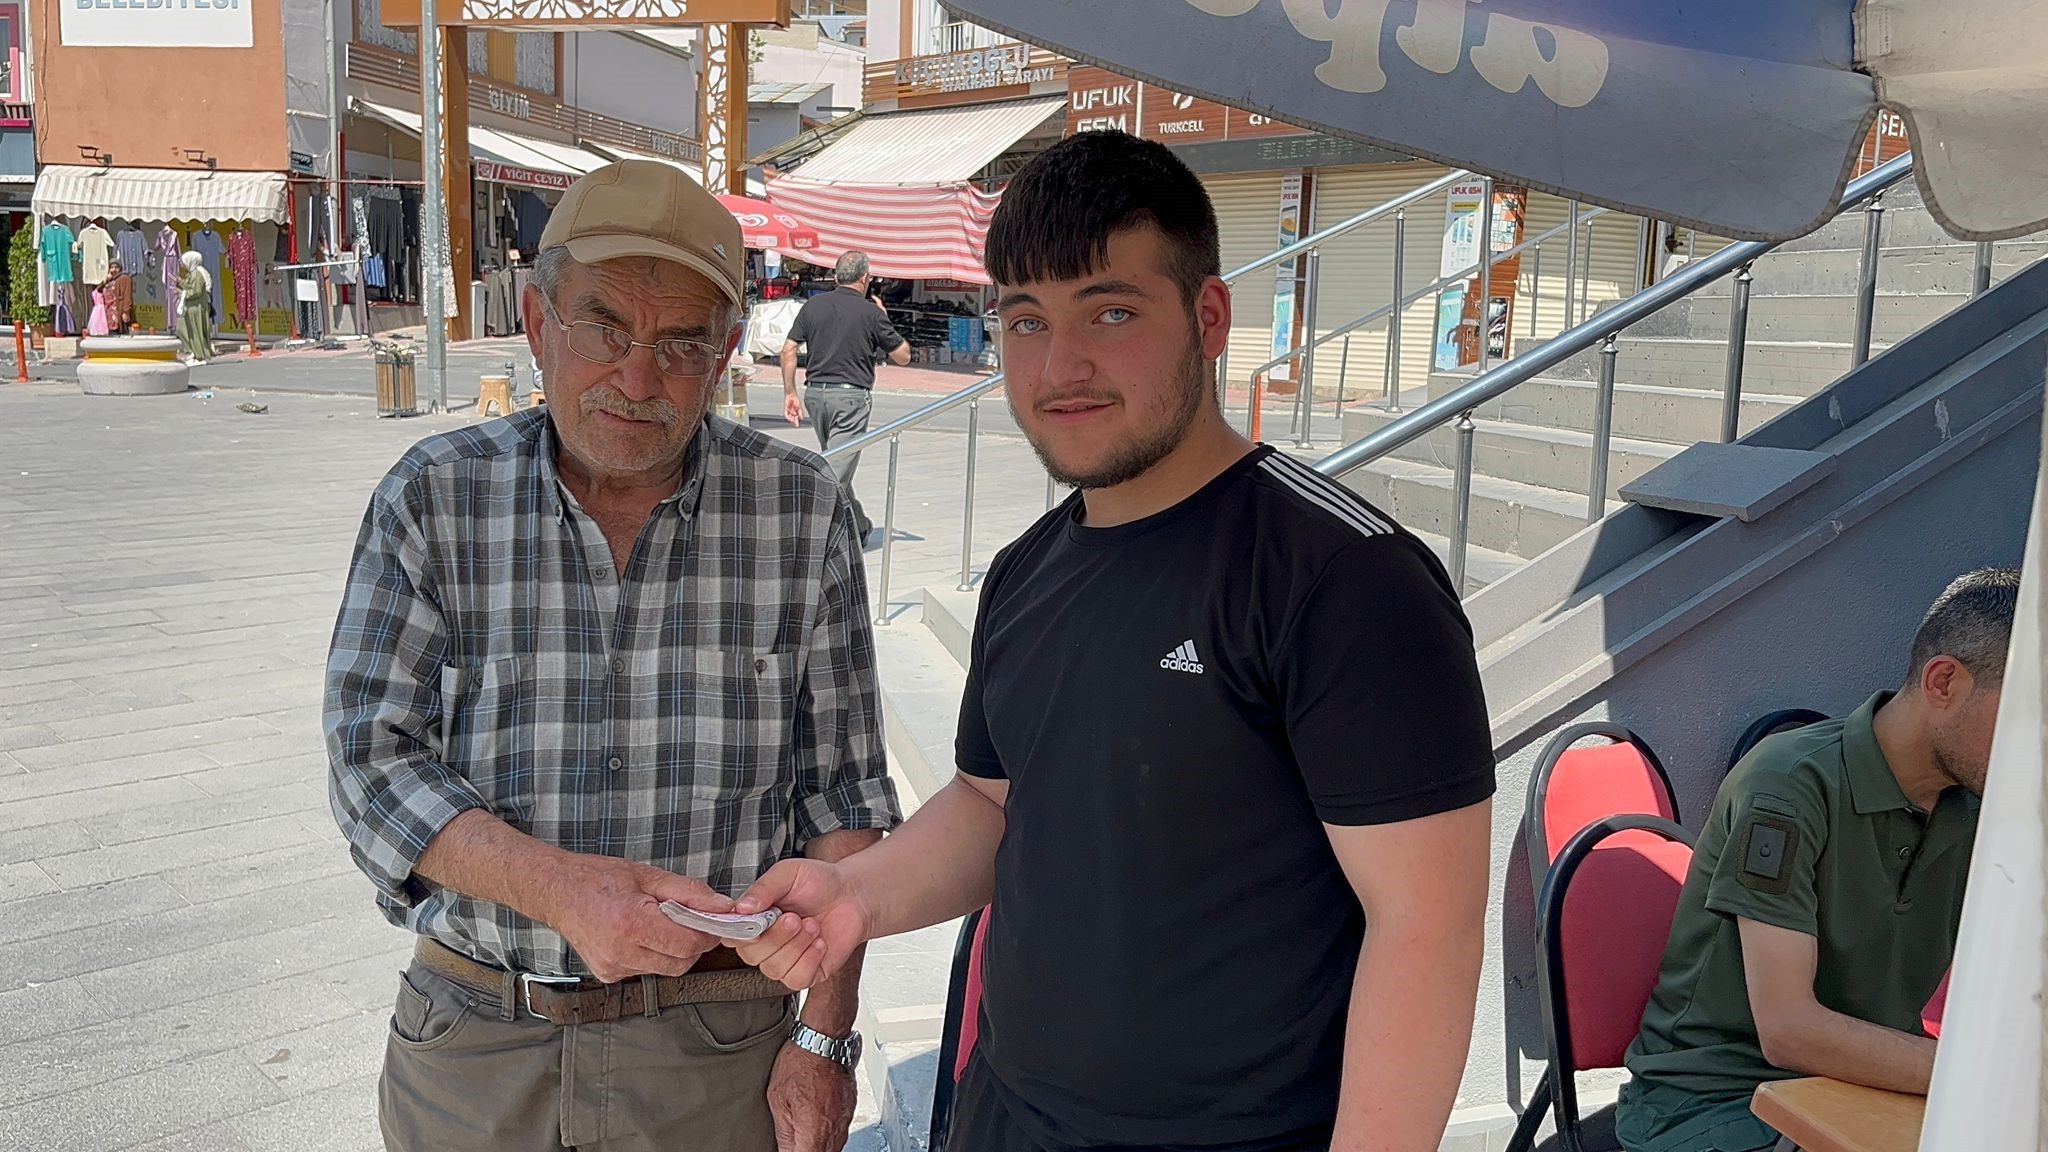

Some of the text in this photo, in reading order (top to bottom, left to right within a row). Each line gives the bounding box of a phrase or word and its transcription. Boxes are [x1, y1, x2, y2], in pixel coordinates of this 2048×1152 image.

[1073, 84, 1134, 110] UFUK
[1077, 113, 1127, 133] GSM
[1160, 657, 1204, 674] adidas
